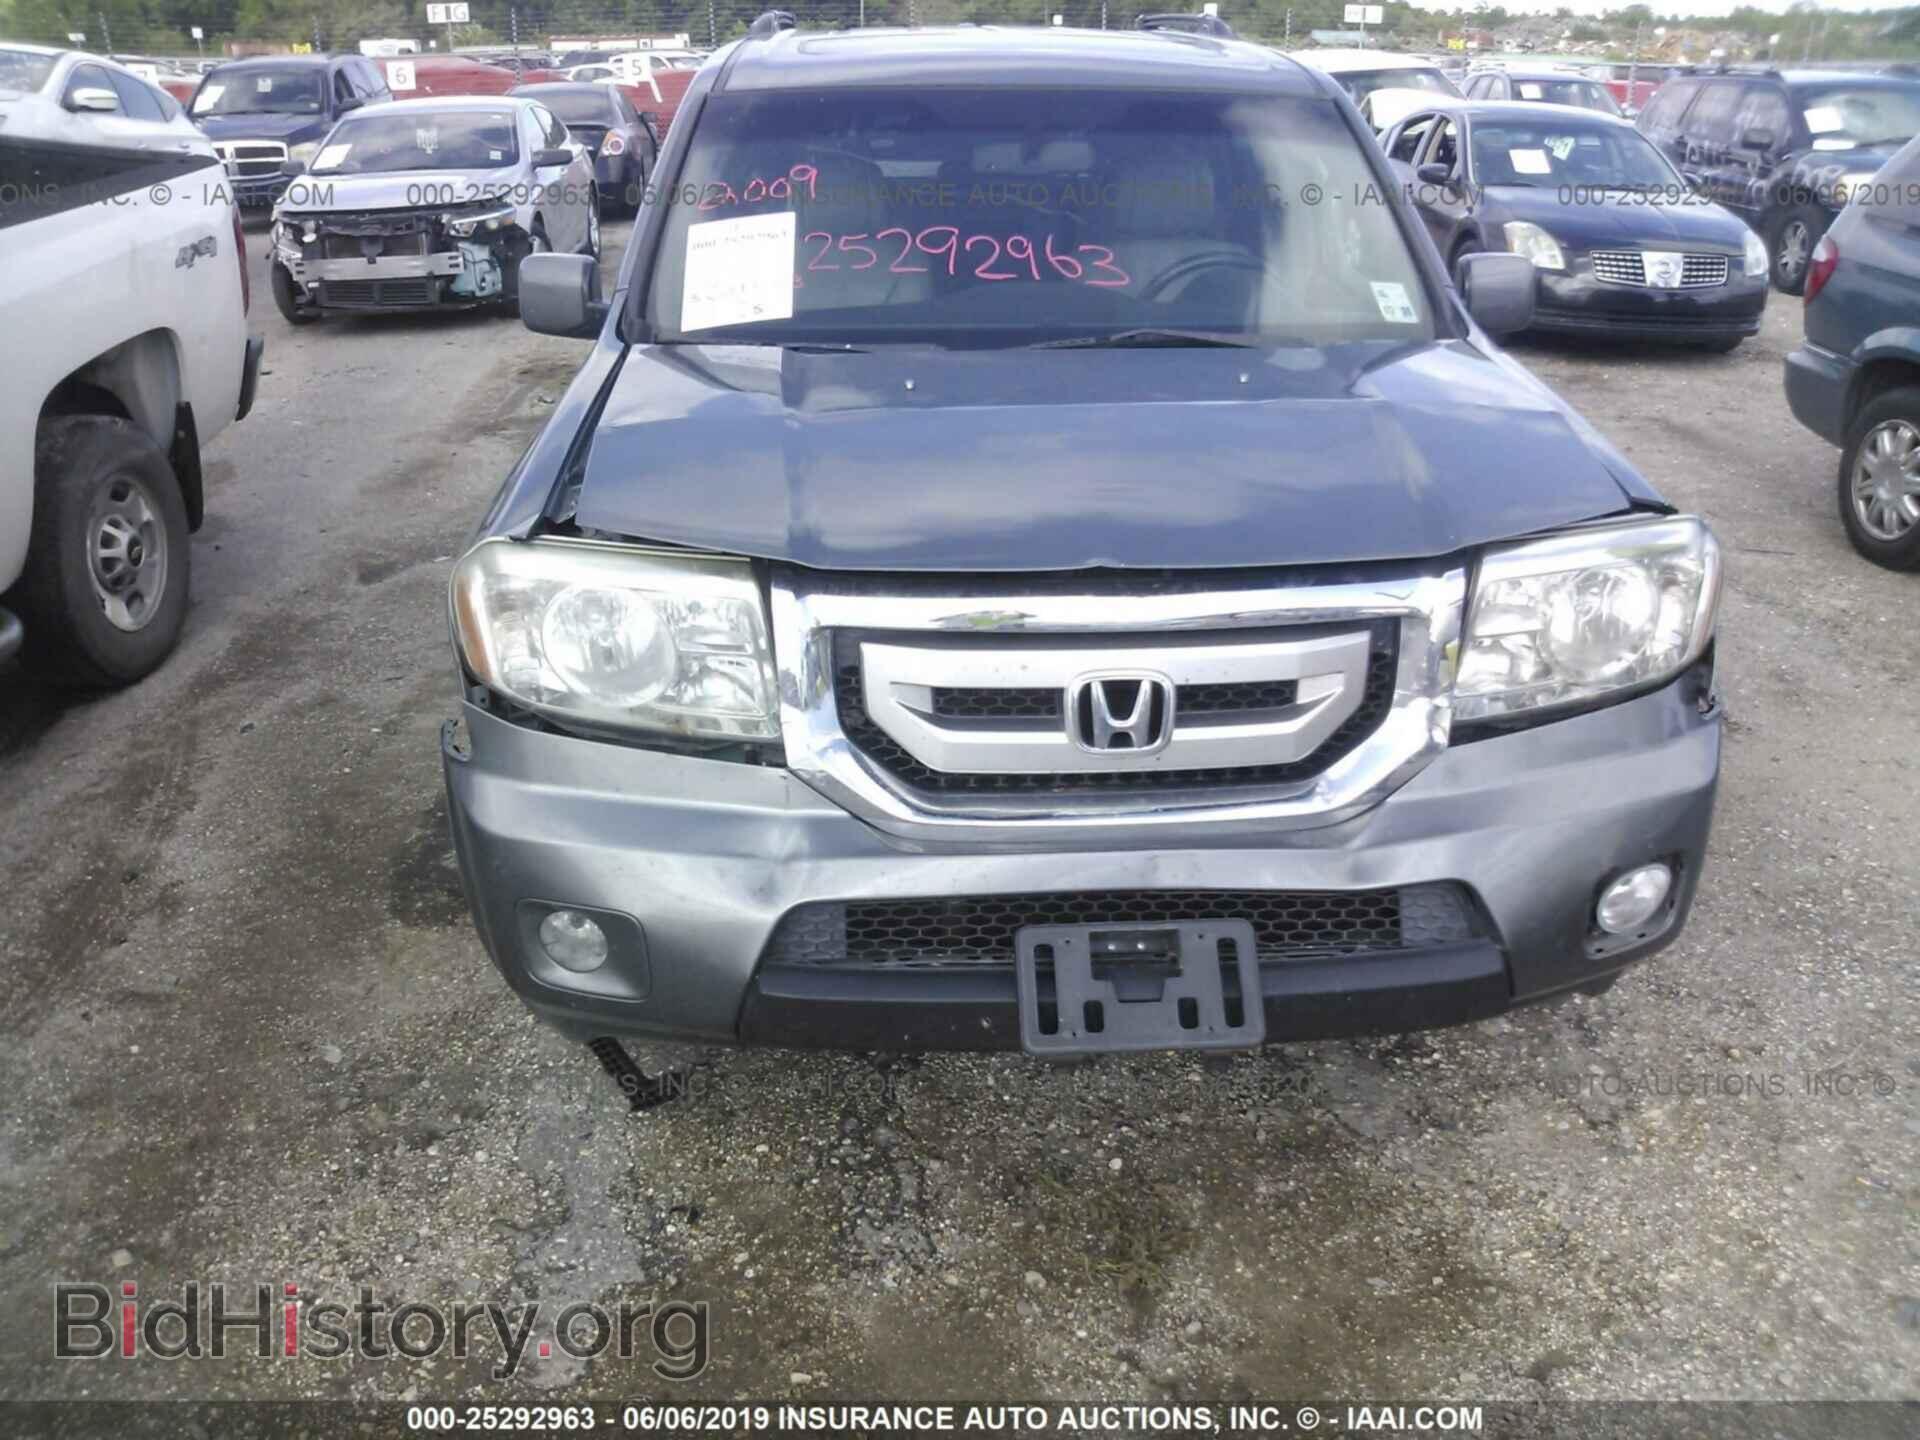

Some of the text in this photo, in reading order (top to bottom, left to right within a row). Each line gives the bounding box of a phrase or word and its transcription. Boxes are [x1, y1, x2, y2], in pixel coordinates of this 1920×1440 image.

[395, 66, 407, 85] 6
[631, 59, 642, 76] 5
[698, 165, 817, 209] 2009
[804, 226, 1130, 287] 25292963
